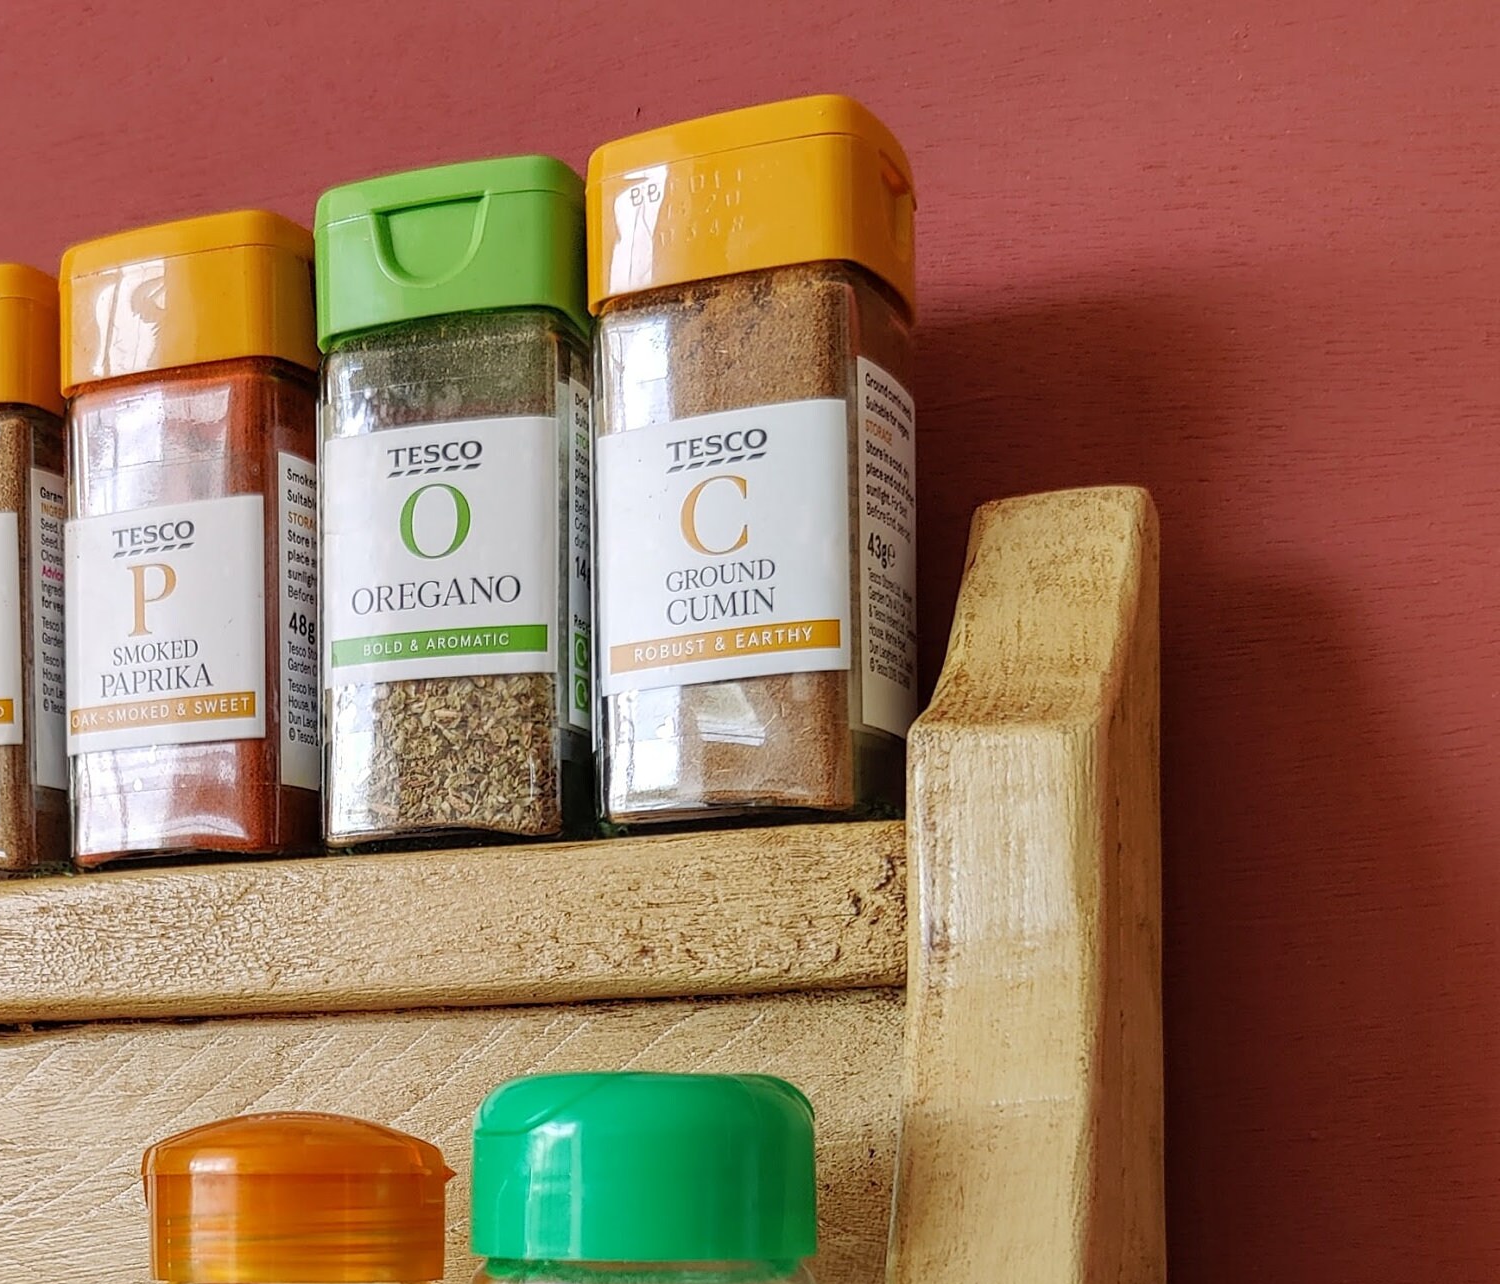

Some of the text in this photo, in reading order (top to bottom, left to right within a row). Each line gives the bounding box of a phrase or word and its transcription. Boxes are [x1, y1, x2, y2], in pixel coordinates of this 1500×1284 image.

[387, 440, 483, 468] TESCO
[666, 428, 767, 462] TESCO
[399, 483, 471, 560] O
[681, 475, 748, 556] C
[112, 520, 194, 549] TESCO
[287, 529, 310, 547] Store
[287, 550, 310, 567] place
[666, 559, 775, 592] GROUND
[126, 563, 177, 637] P
[287, 585, 314, 604] Before
[351, 574, 521, 616] OREGANO
[667, 586, 775, 625] CUMIN
[289, 612, 315, 645] 48g
[363, 633, 510, 656] BOLD & AROMATIC
[634, 626, 813, 662] ROBUST & EARTHY
[113, 638, 198, 667] SMOKED
[288, 641, 306, 658] Tesco
[100, 663, 214, 698] PAPRIKA
[71, 697, 250, 728] OAK-SMOKED & SWEET
